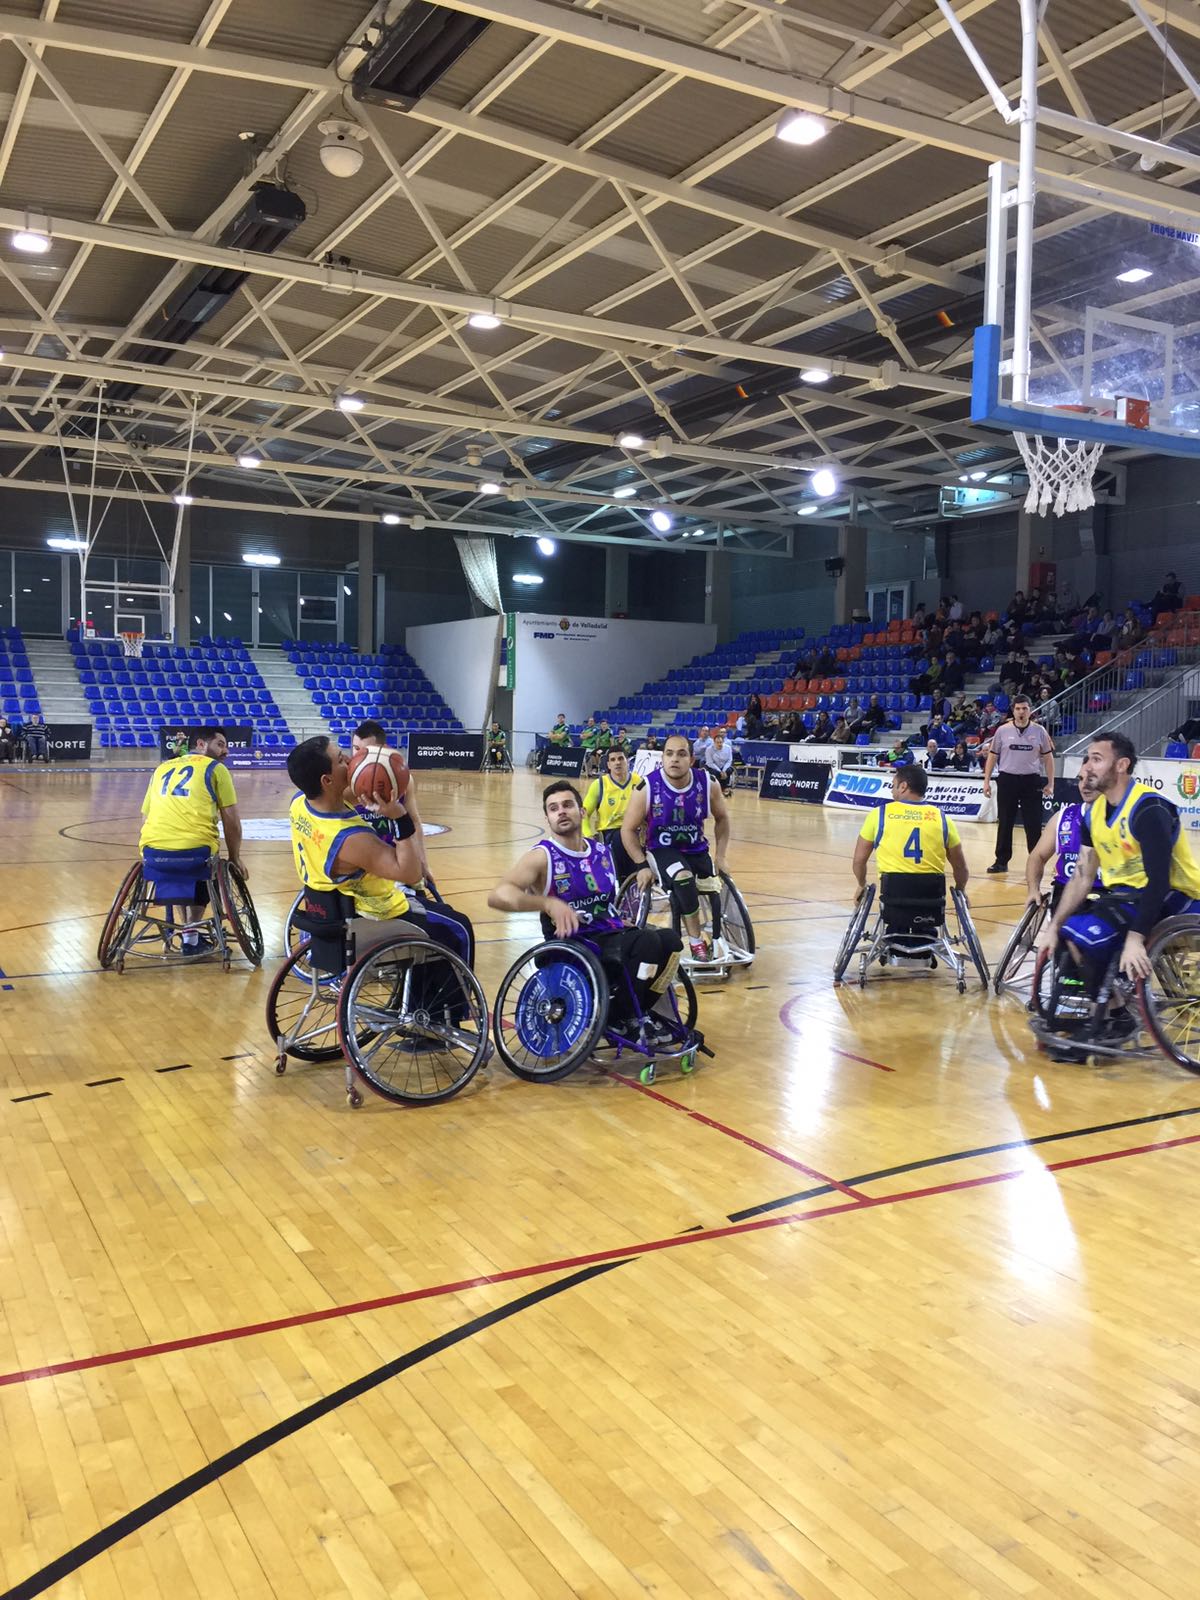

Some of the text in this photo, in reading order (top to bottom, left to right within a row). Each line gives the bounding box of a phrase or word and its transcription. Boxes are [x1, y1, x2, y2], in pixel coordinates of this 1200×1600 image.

[581, 622, 608, 630] Valladolid
[533, 632, 555, 640] FMD
[562, 760, 579, 768] NORTE
[161, 765, 194, 797] 12
[769, 778, 820, 790] GRUPO NORTE
[833, 773, 883, 794] FMD
[888, 812, 923, 821] Canarias
[903, 827, 924, 865] 4
[585, 873, 599, 891] 8
